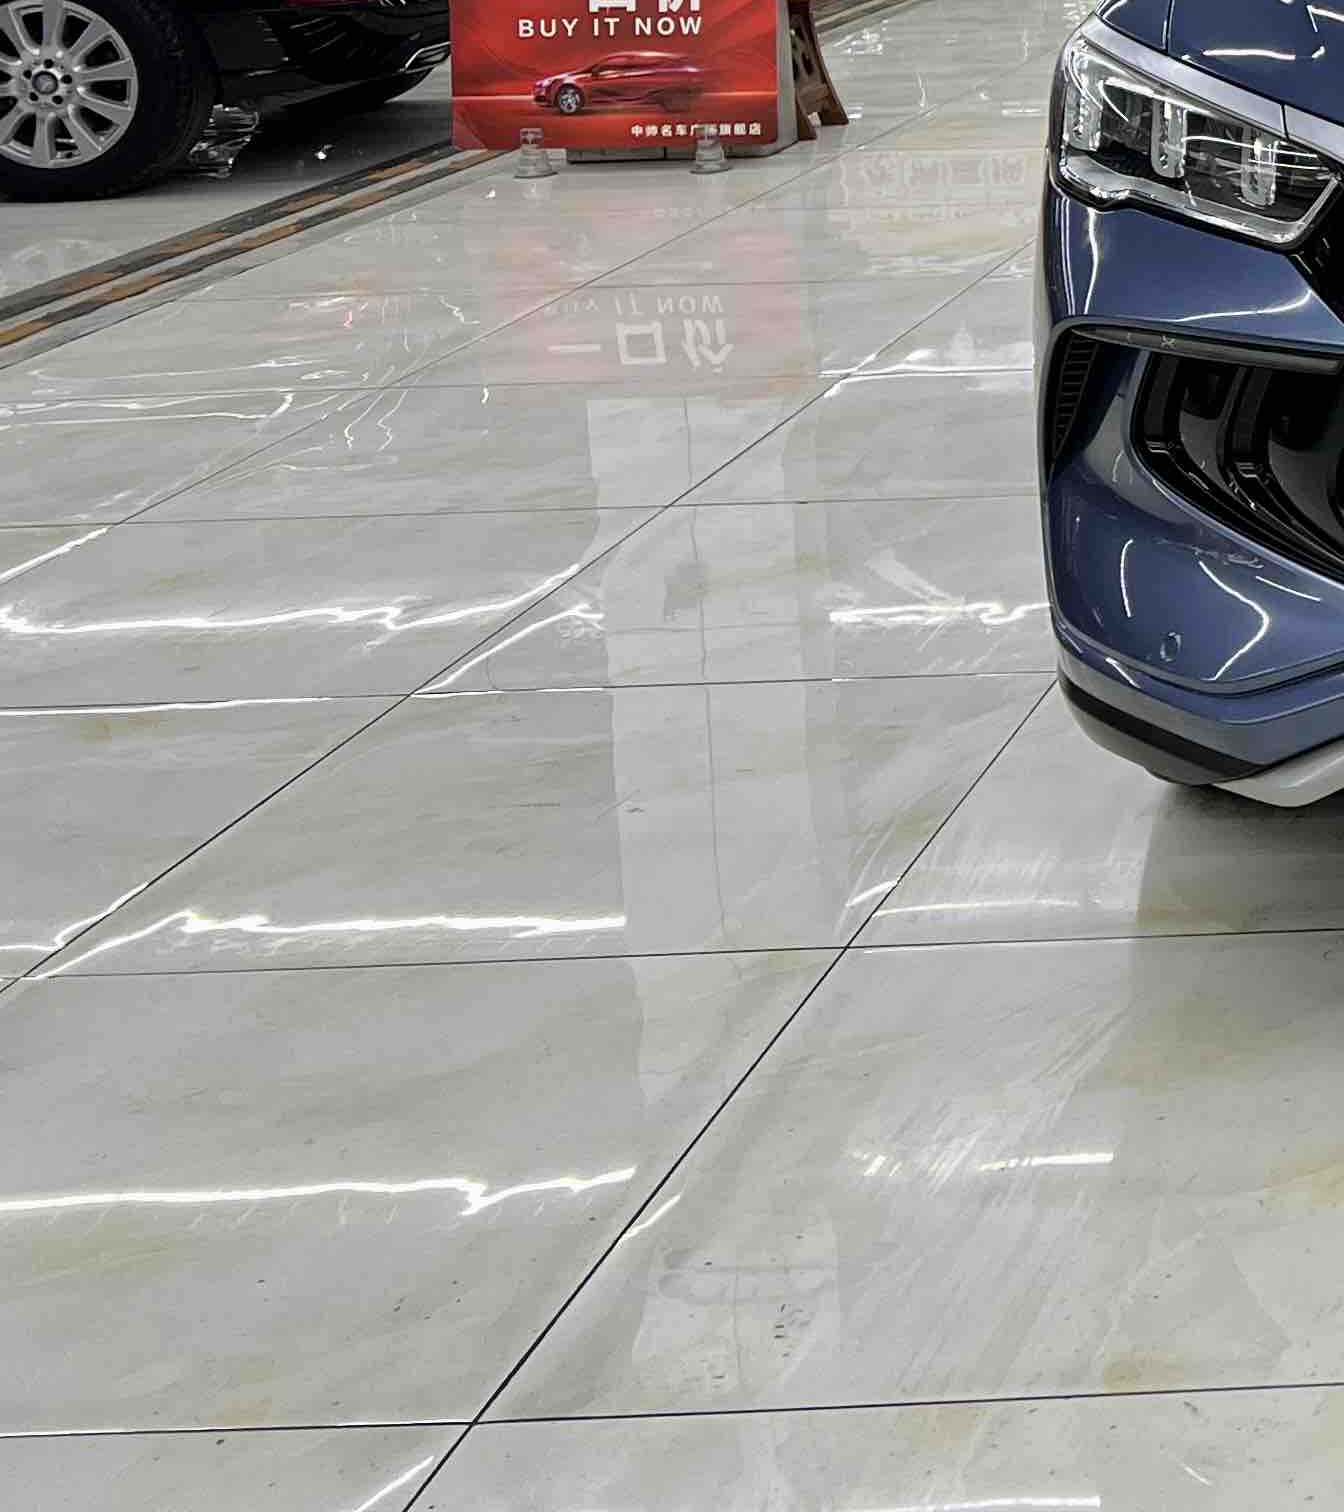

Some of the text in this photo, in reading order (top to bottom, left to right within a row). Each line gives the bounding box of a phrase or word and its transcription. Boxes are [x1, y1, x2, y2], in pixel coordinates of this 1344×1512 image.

[518, 16, 703, 38] BUY IT NOW
